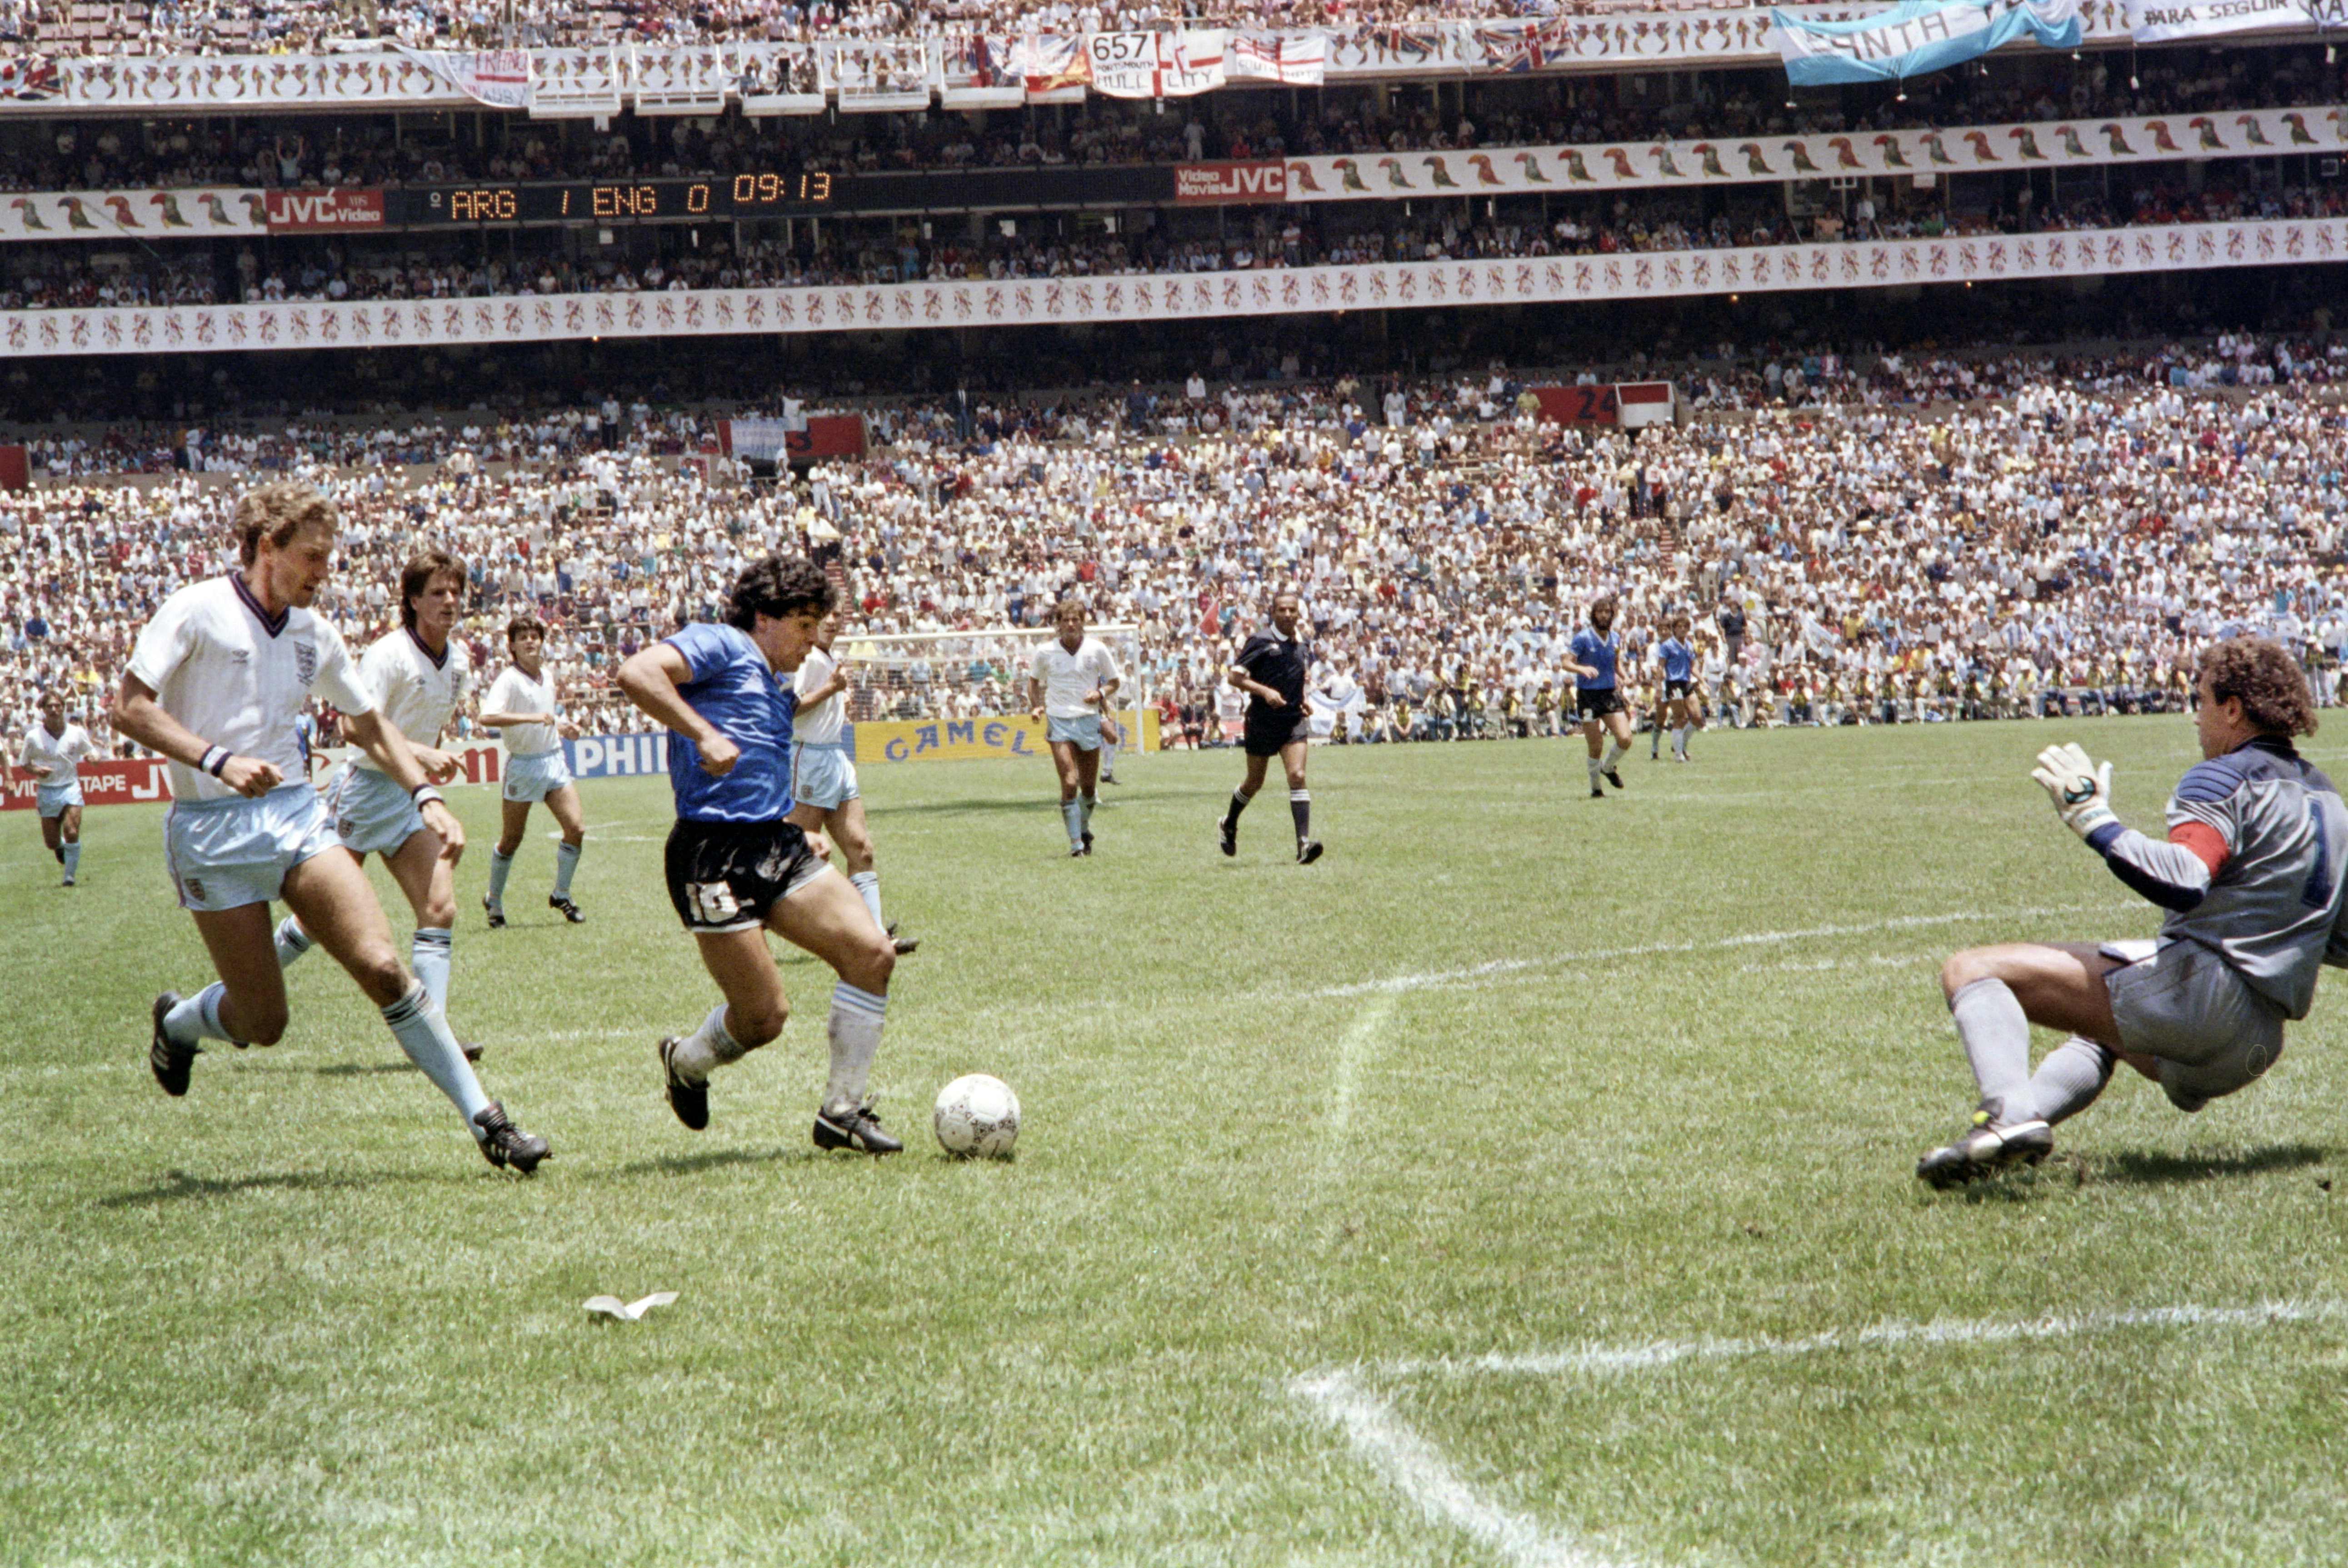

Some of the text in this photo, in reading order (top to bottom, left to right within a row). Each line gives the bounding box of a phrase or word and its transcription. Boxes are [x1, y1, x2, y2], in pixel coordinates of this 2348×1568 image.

[2144, 7, 2197, 25] PARA
[2208, 0, 2288, 20] SEGUIR
[1093, 34, 1148, 61] 657
[1095, 60, 1154, 72] PORTSMOUTH
[1178, 169, 1220, 181] Video
[1220, 166, 1284, 194] JVC
[452, 190, 516, 220] ARG
[561, 190, 569, 215] 1
[593, 186, 657, 215] ENG
[688, 184, 709, 212] 0
[1178, 182, 1221, 196] Movie
[270, 196, 336, 223] JVC
[337, 208, 380, 222] Video
[1577, 386, 1616, 419] 24
[884, 720, 1034, 761] CAMEL
[79, 774, 126, 793] TAPE
[131, 764, 174, 799] JV
[2301, 799, 2335, 908] 1
[685, 880, 740, 923] 10
